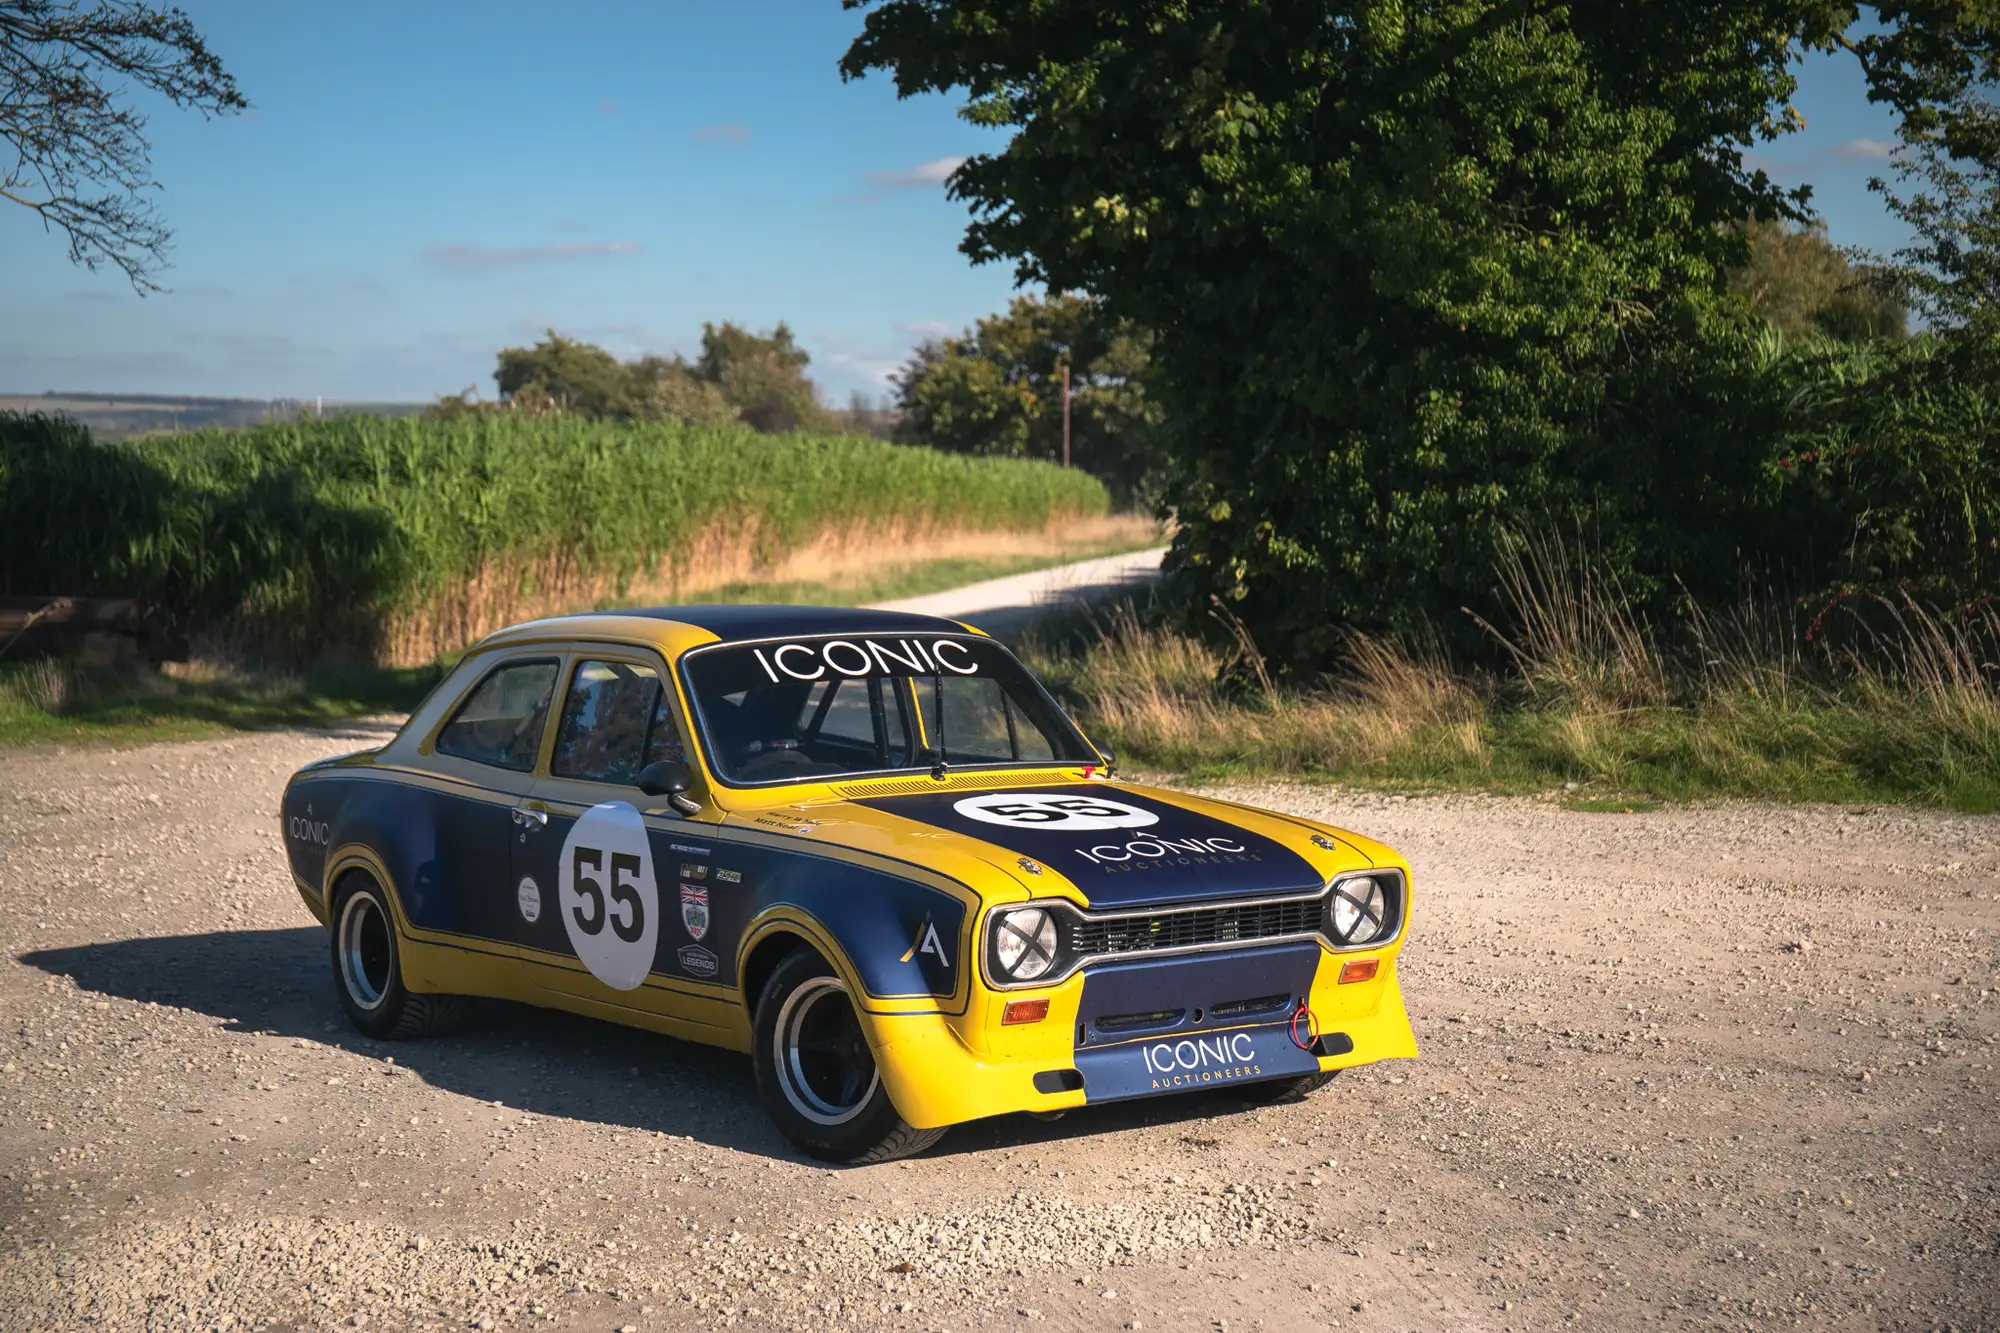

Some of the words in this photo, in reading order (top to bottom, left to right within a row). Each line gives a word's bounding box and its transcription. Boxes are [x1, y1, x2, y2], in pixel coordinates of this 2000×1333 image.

[753, 639, 979, 684] ICONIC
[753, 817, 776, 826] Matt
[976, 799, 1131, 822] 55
[289, 815, 330, 846] ICONIC
[1075, 837, 1245, 864] ICONIC
[1105, 853, 1262, 874] AUCTIONEERS
[571, 845, 645, 943] 55
[682, 956, 715, 970] LEGENDS
[1142, 1033, 1255, 1074] ICONIC
[1151, 1065, 1261, 1089] AUCTIONEERS
